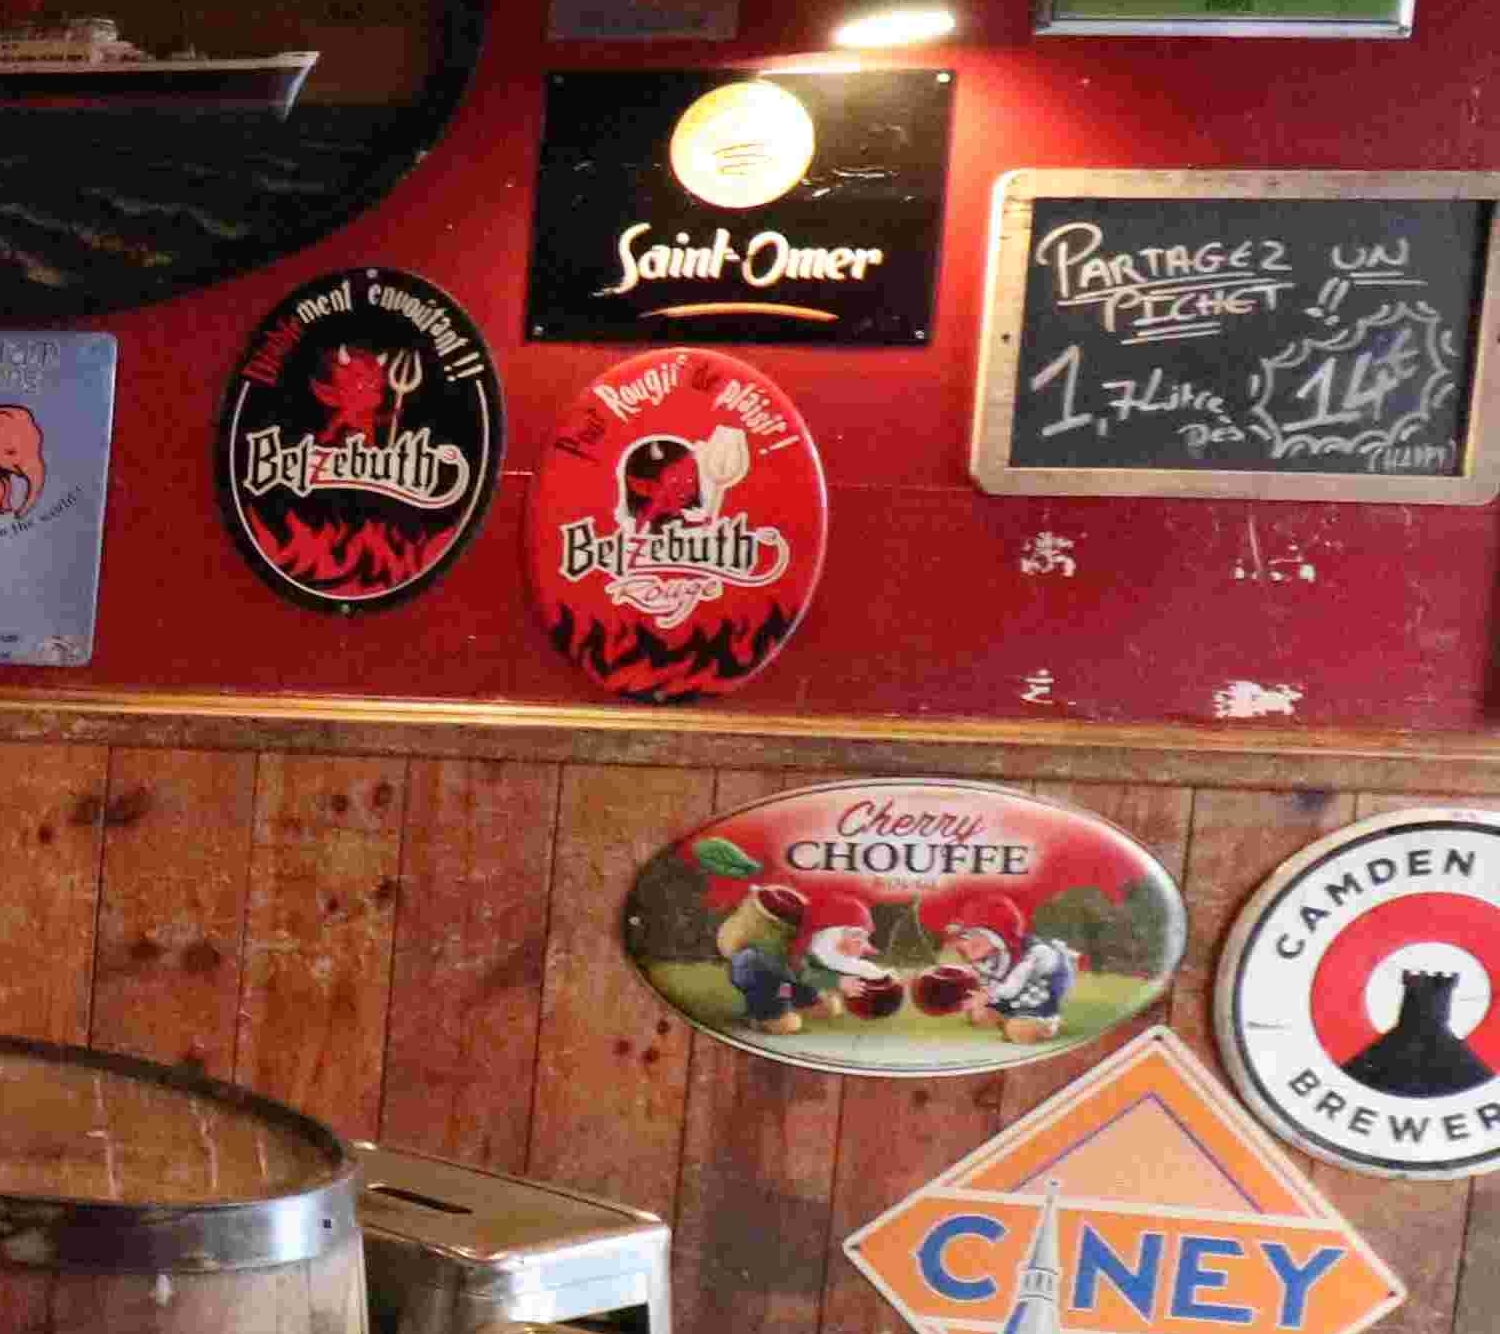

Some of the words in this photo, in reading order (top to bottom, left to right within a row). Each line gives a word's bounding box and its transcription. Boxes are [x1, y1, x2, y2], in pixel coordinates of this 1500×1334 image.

[589, 221, 884, 298] Saint-Omer
[1330, 237, 1410, 271] UN
[593, 362, 682, 425] Rougir
[711, 379, 787, 438] plaisir
[243, 425, 446, 501] Belzebuth
[559, 513, 764, 582] Belzebuth
[604, 571, 725, 630] Rouge
[836, 797, 986, 846] Cherry
[785, 839, 1030, 876] CHOUFFE
[1275, 848, 1477, 961] CAMDEN
